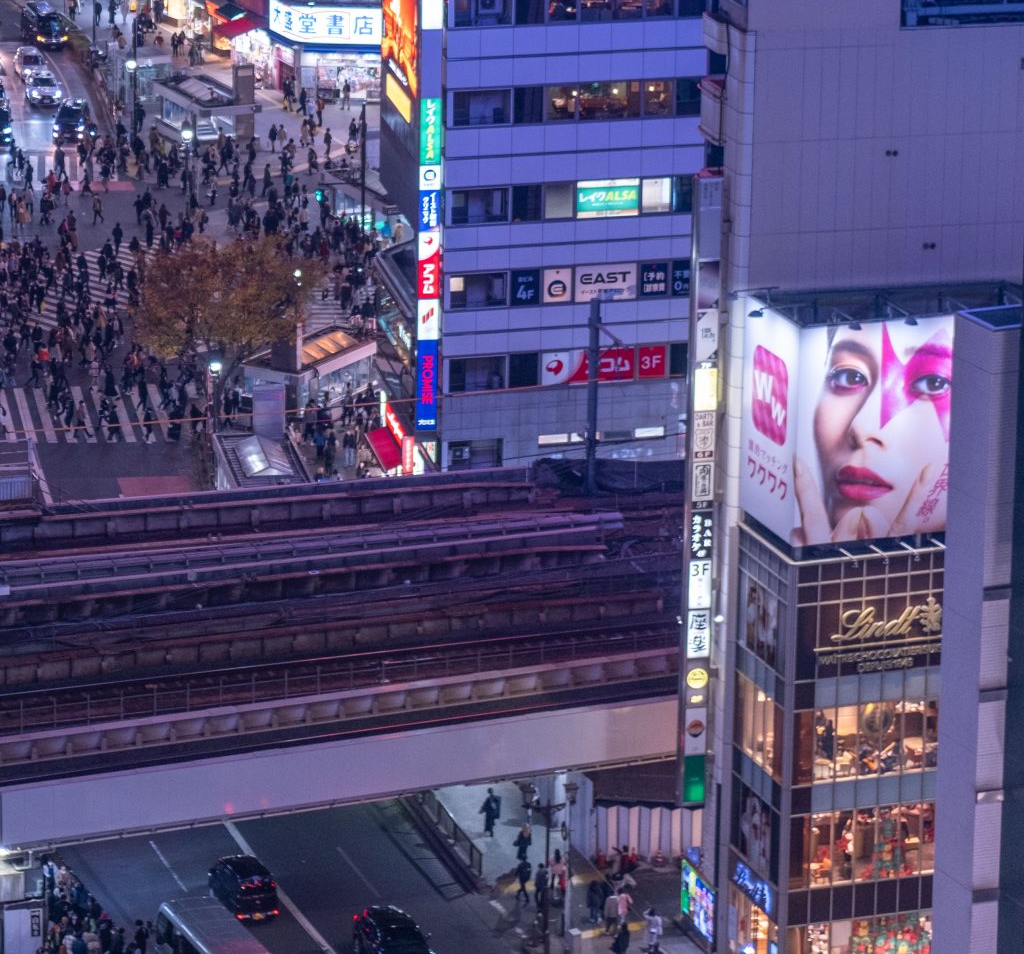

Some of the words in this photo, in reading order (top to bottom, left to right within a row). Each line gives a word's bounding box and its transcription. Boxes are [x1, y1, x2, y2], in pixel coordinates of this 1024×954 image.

[579, 189, 637, 203] レイクALSA
[423, 263, 436, 296] アコム
[580, 271, 631, 285] EAST
[516, 285, 534, 301] 4F
[640, 355, 662, 369] 3F
[421, 355, 434, 405] PROMISE
[695, 413, 714, 421] DARTS
[747, 455, 788, 501] ワクワク
[692, 563, 709, 576] 3F
[830, 606, 922, 642] Lindt
